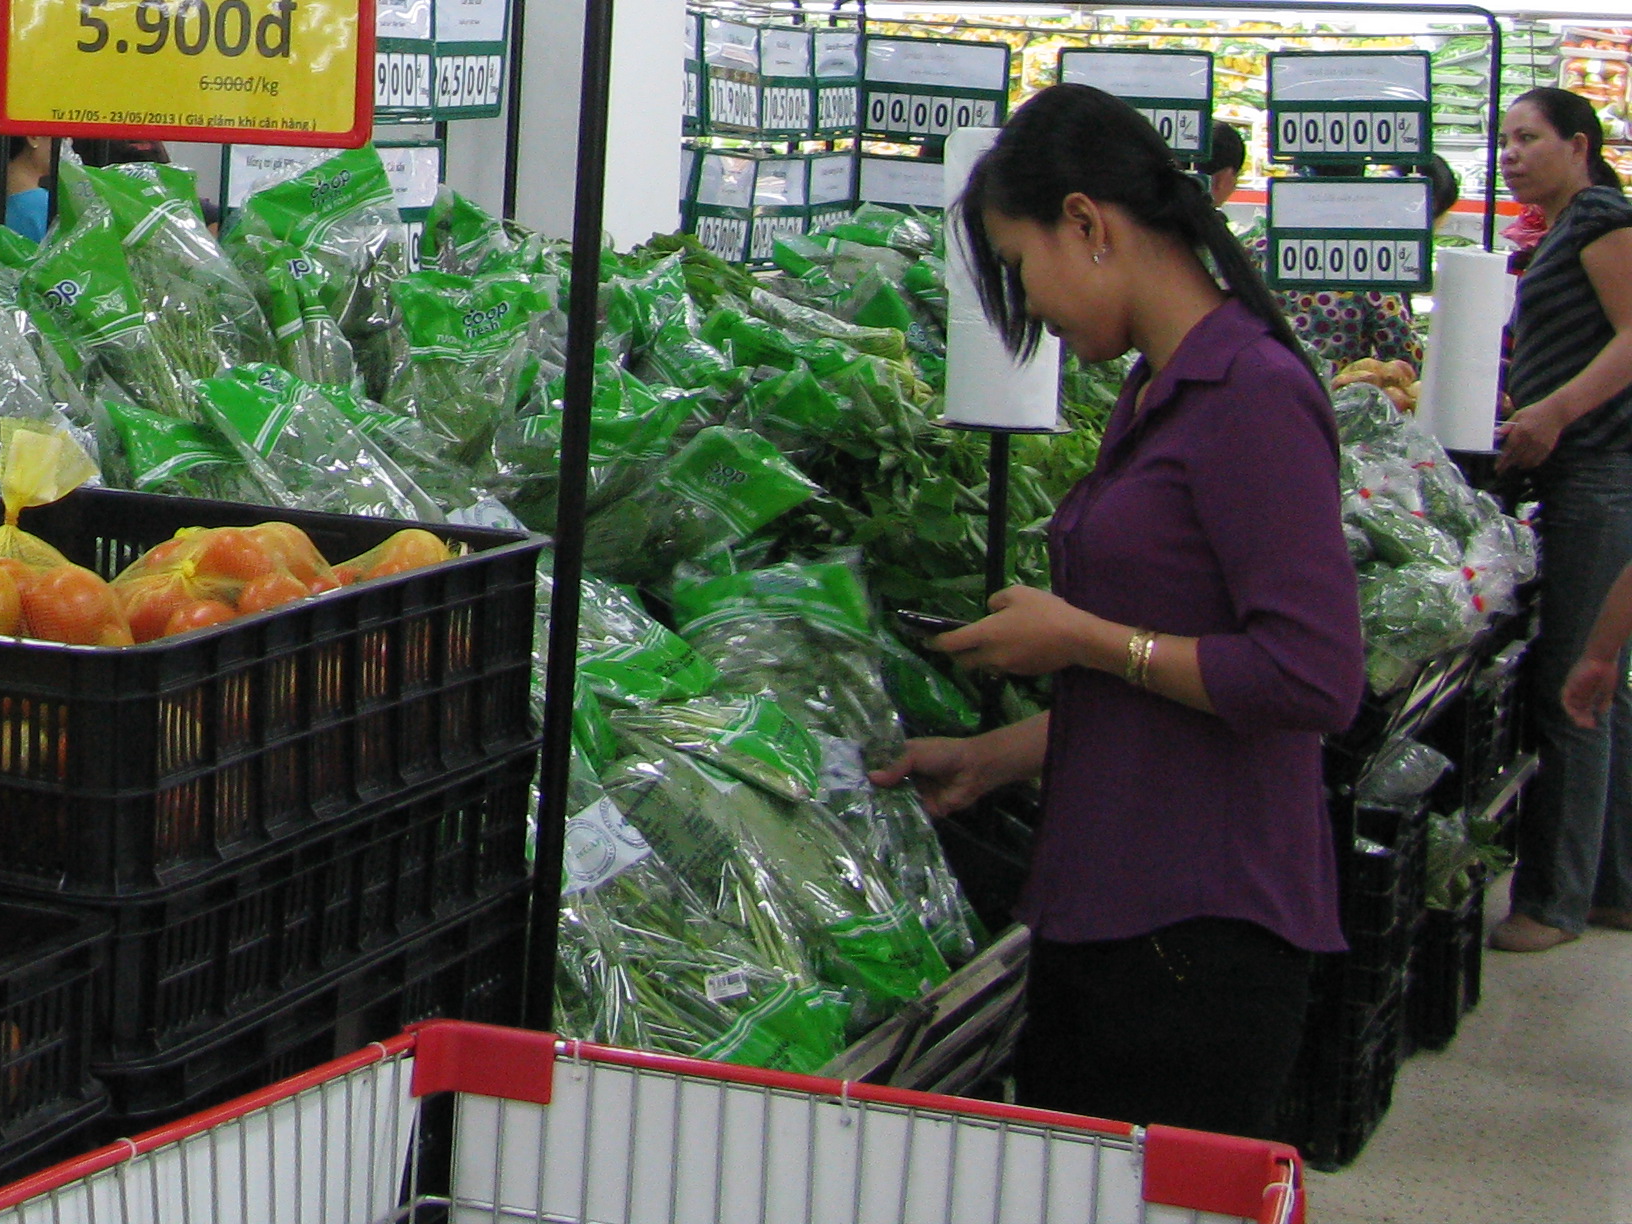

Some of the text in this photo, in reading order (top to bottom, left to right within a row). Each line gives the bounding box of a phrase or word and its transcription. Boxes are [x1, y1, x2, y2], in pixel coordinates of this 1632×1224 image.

[200, 75, 280, 96] 6.900đ/kg
[67, 109, 100, 122] 17/05
[109, 111, 176, 125] 23/05/2013
